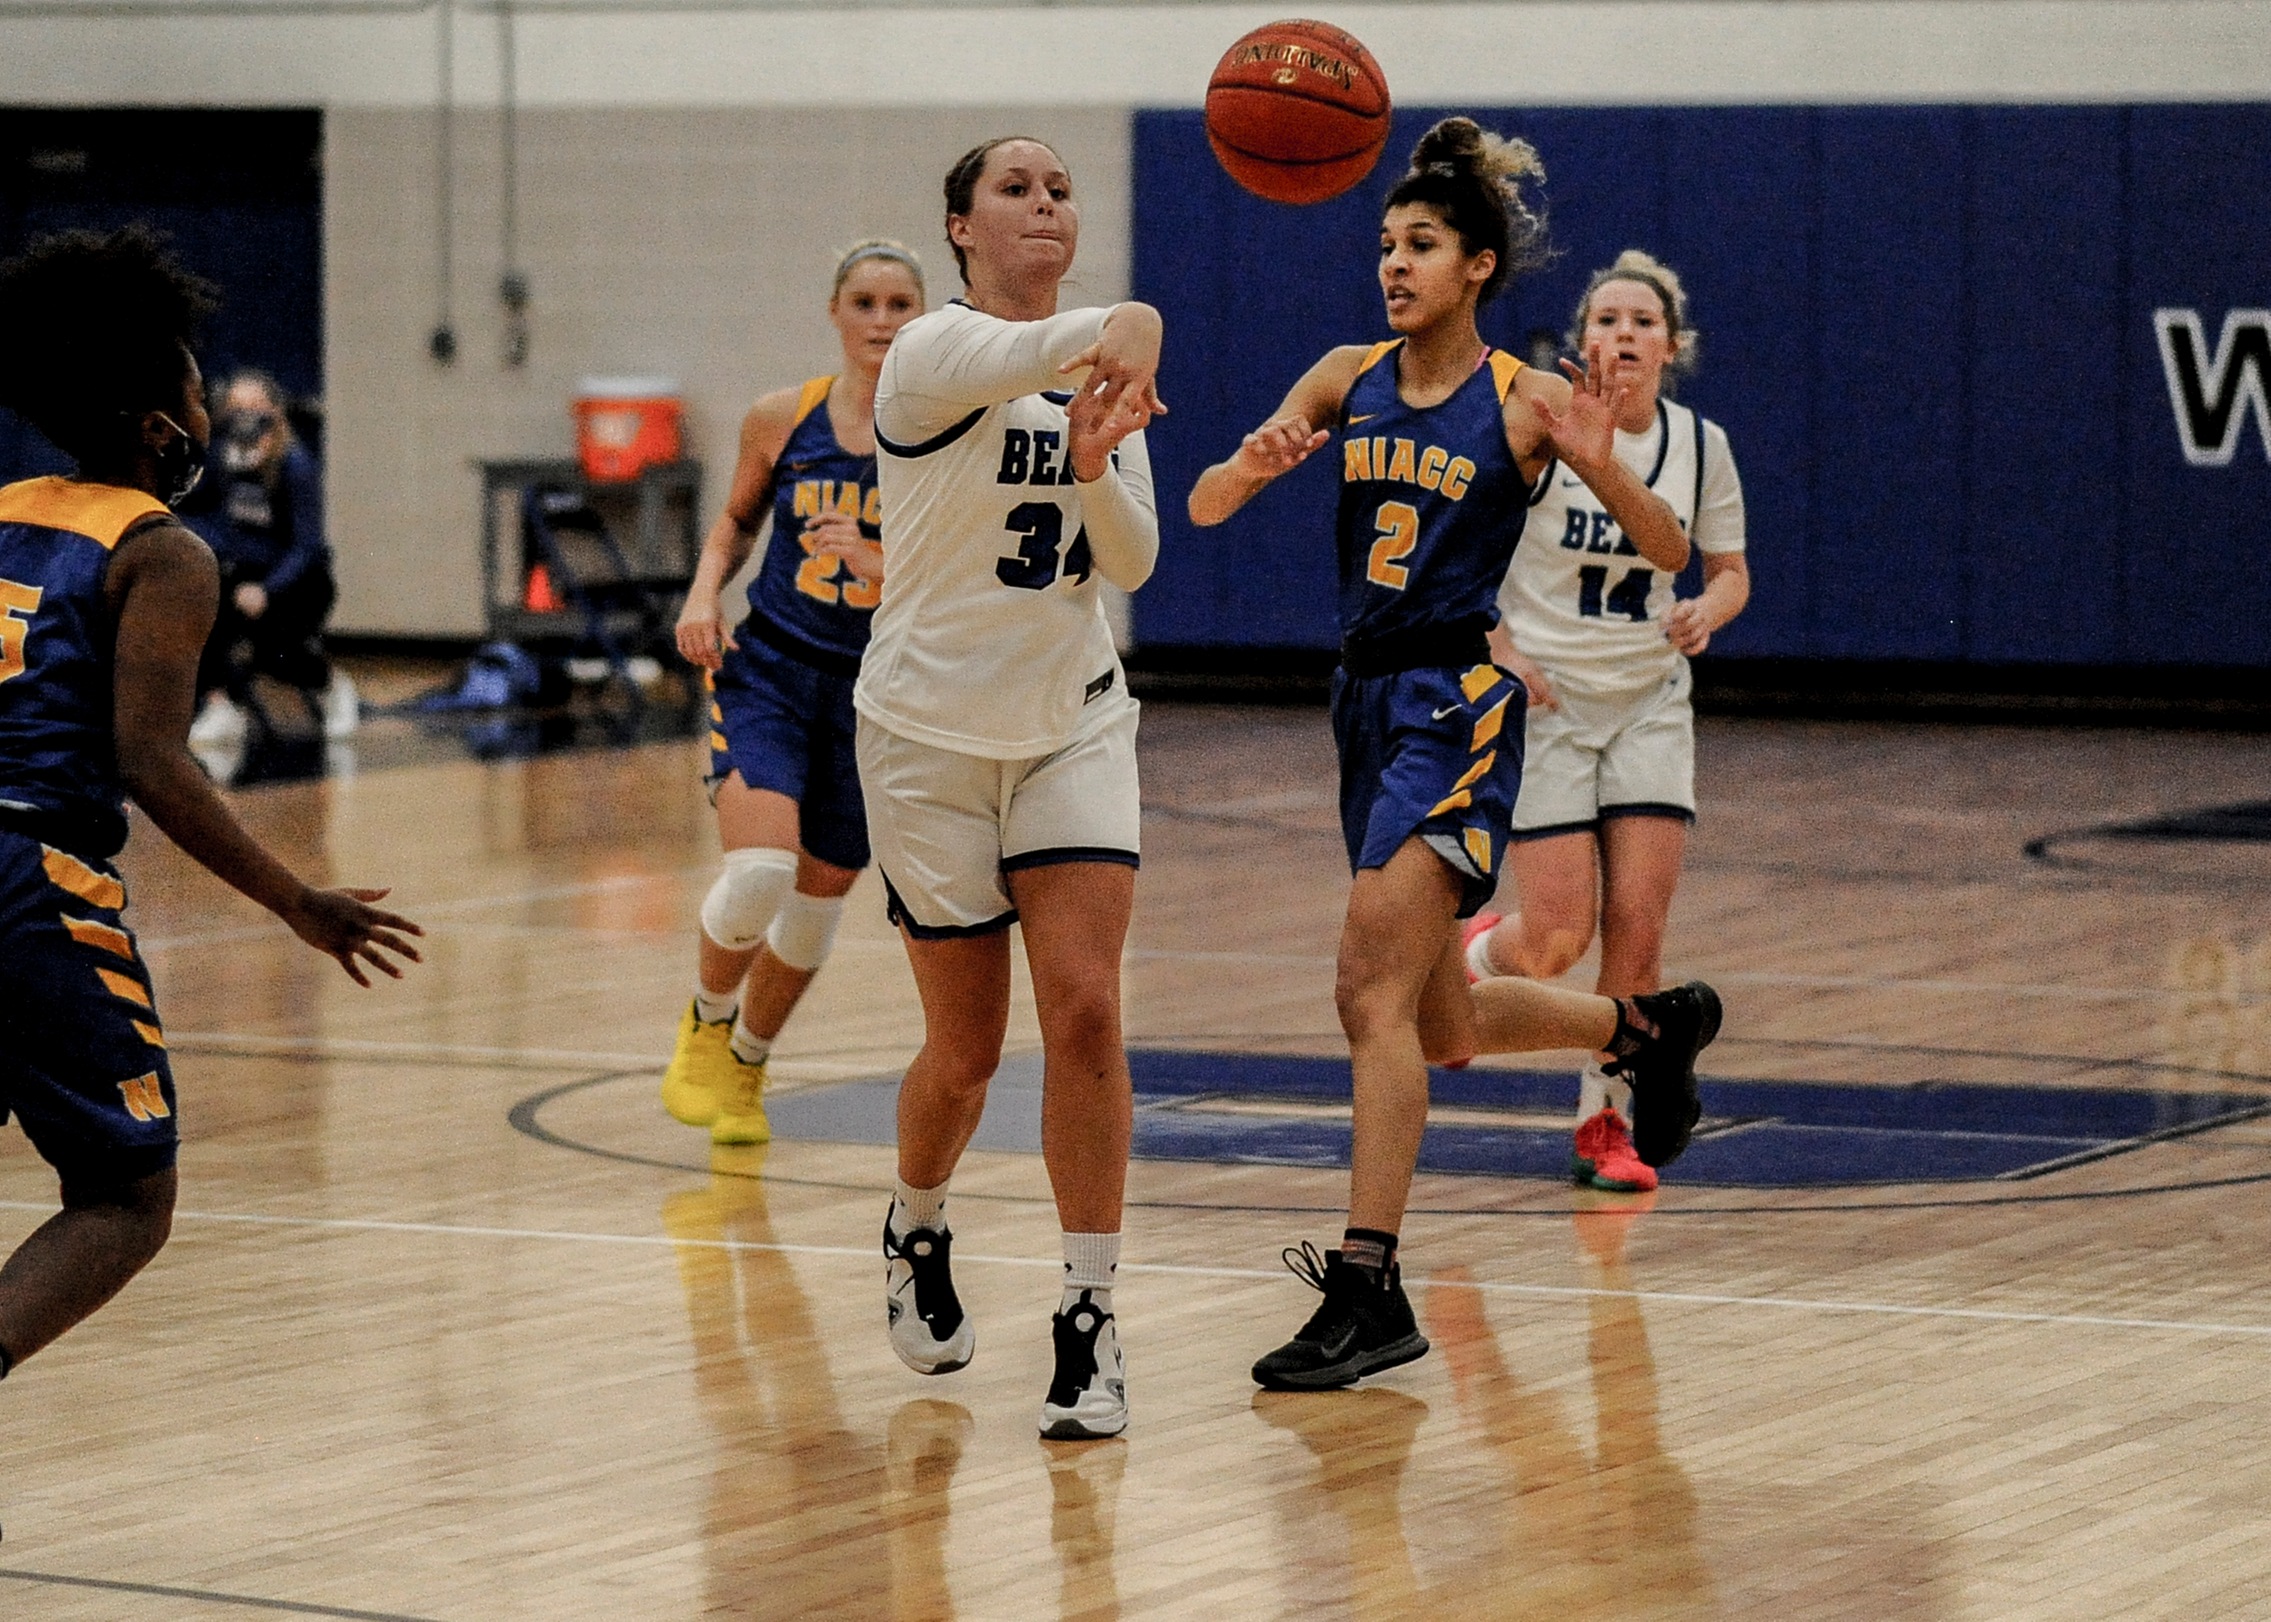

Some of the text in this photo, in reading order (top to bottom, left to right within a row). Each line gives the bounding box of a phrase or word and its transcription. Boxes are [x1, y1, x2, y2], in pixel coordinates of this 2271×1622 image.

[1344, 437, 1476, 501] NIACC
[793, 479, 882, 525] NIAC
[1367, 500, 1419, 591] 2
[1578, 564, 1654, 622] 14
[116, 1070, 171, 1122] N
